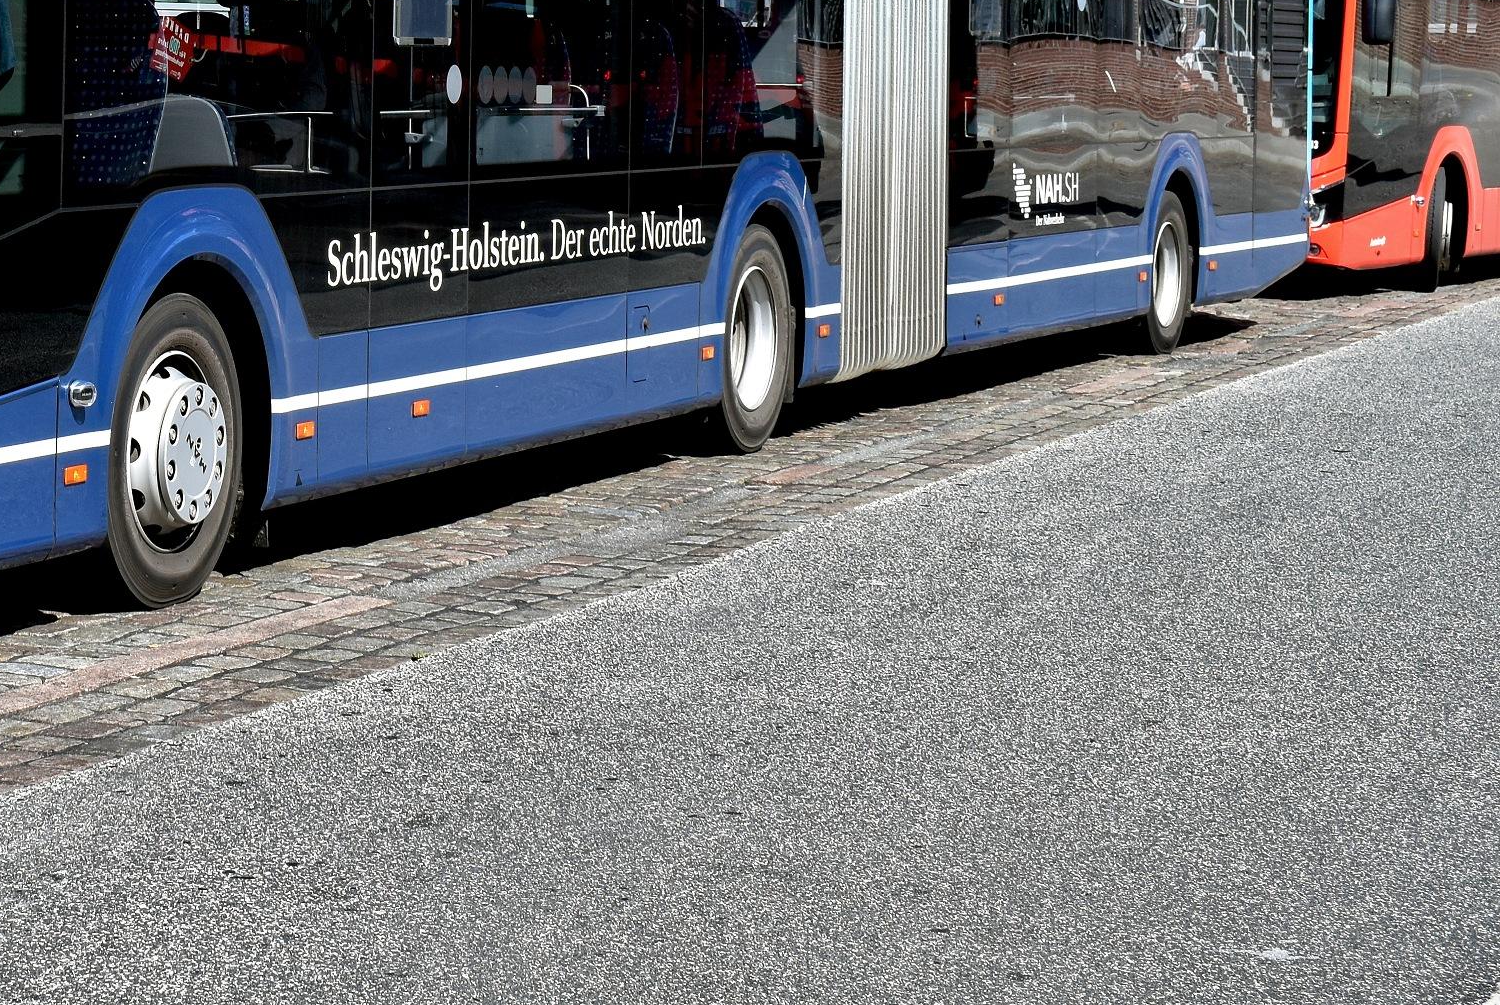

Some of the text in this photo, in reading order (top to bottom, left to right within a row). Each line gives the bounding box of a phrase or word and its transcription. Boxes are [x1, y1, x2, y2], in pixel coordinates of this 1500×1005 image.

[1035, 171, 1079, 205] NAH.SH
[327, 205, 707, 292] Schleswig-Holstein. Der echte Norden.
